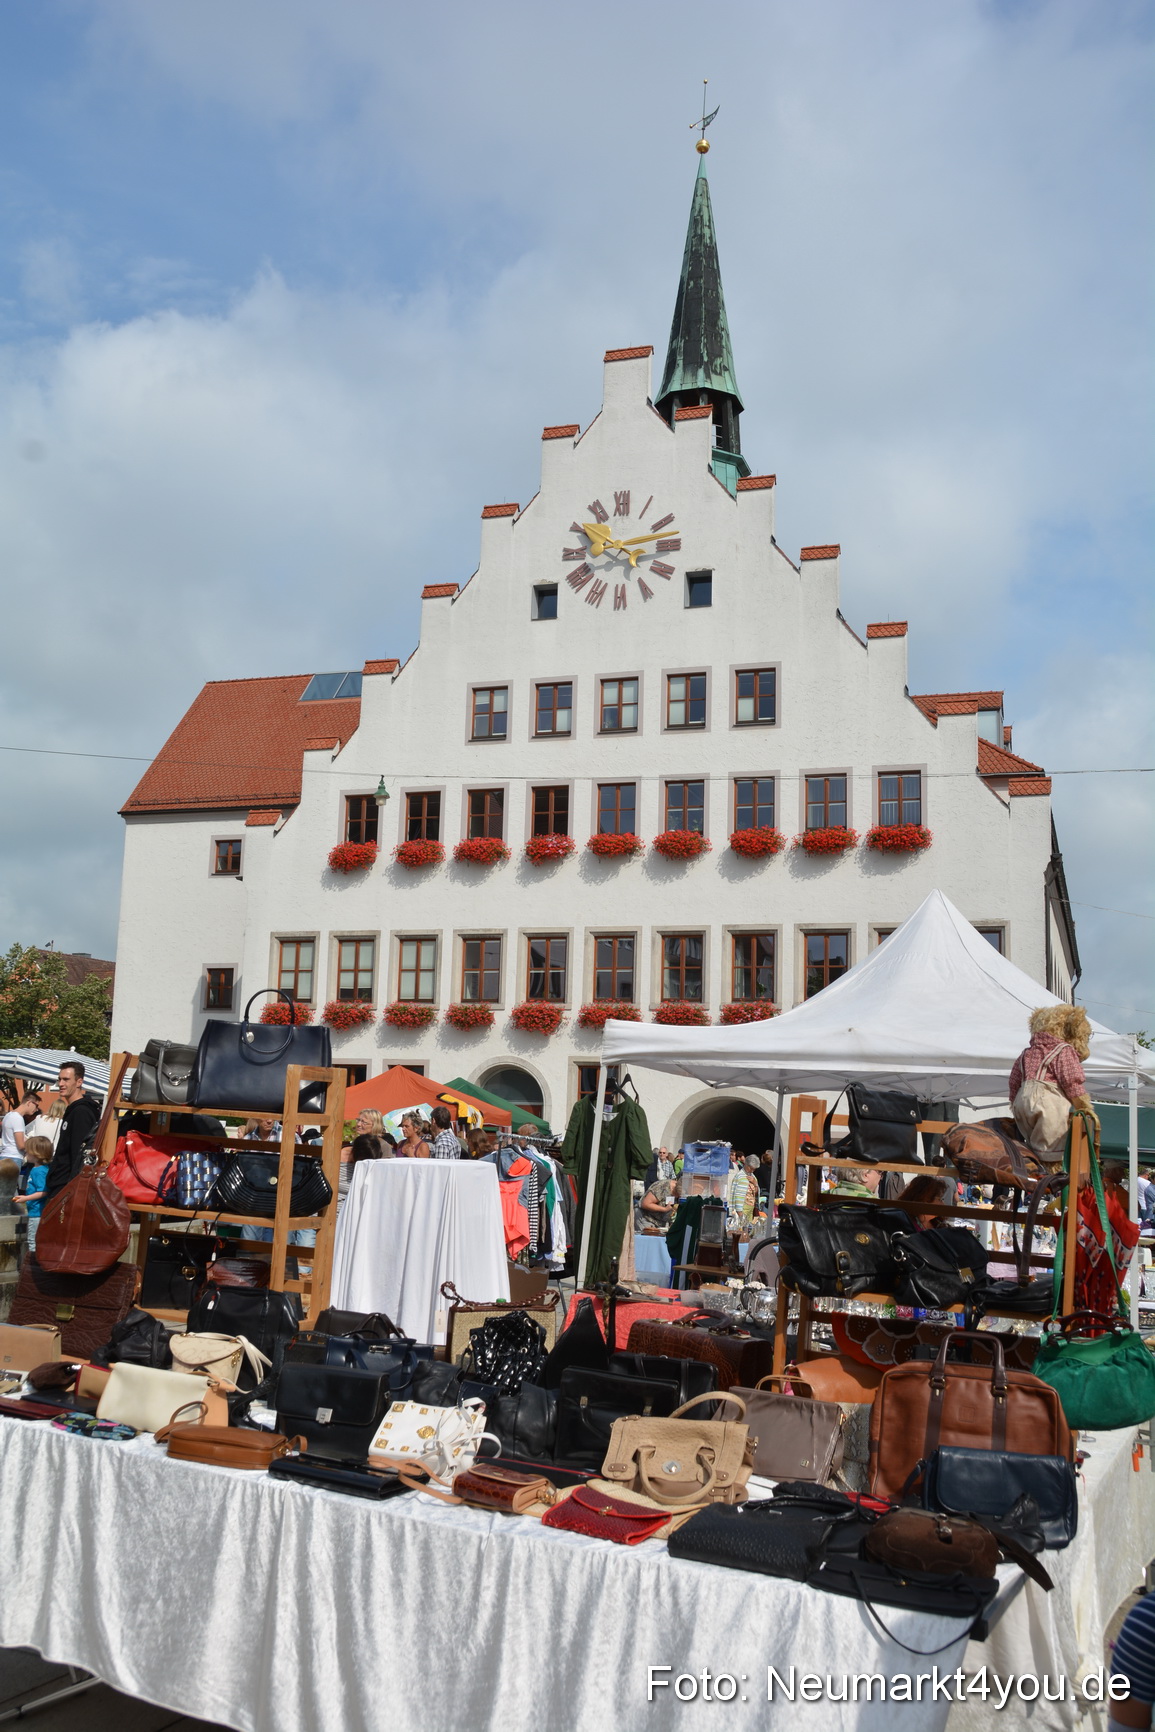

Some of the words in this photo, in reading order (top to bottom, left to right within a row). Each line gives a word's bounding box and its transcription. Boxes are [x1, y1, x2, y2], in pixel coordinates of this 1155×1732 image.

[587, 498, 609, 524] XI
[613, 490, 630, 517] XII
[638, 495, 654, 520] I
[650, 512, 676, 533] II
[562, 545, 587, 561] IX
[655, 538, 682, 552] III
[613, 583, 628, 611] VI
[637, 576, 655, 602] V
